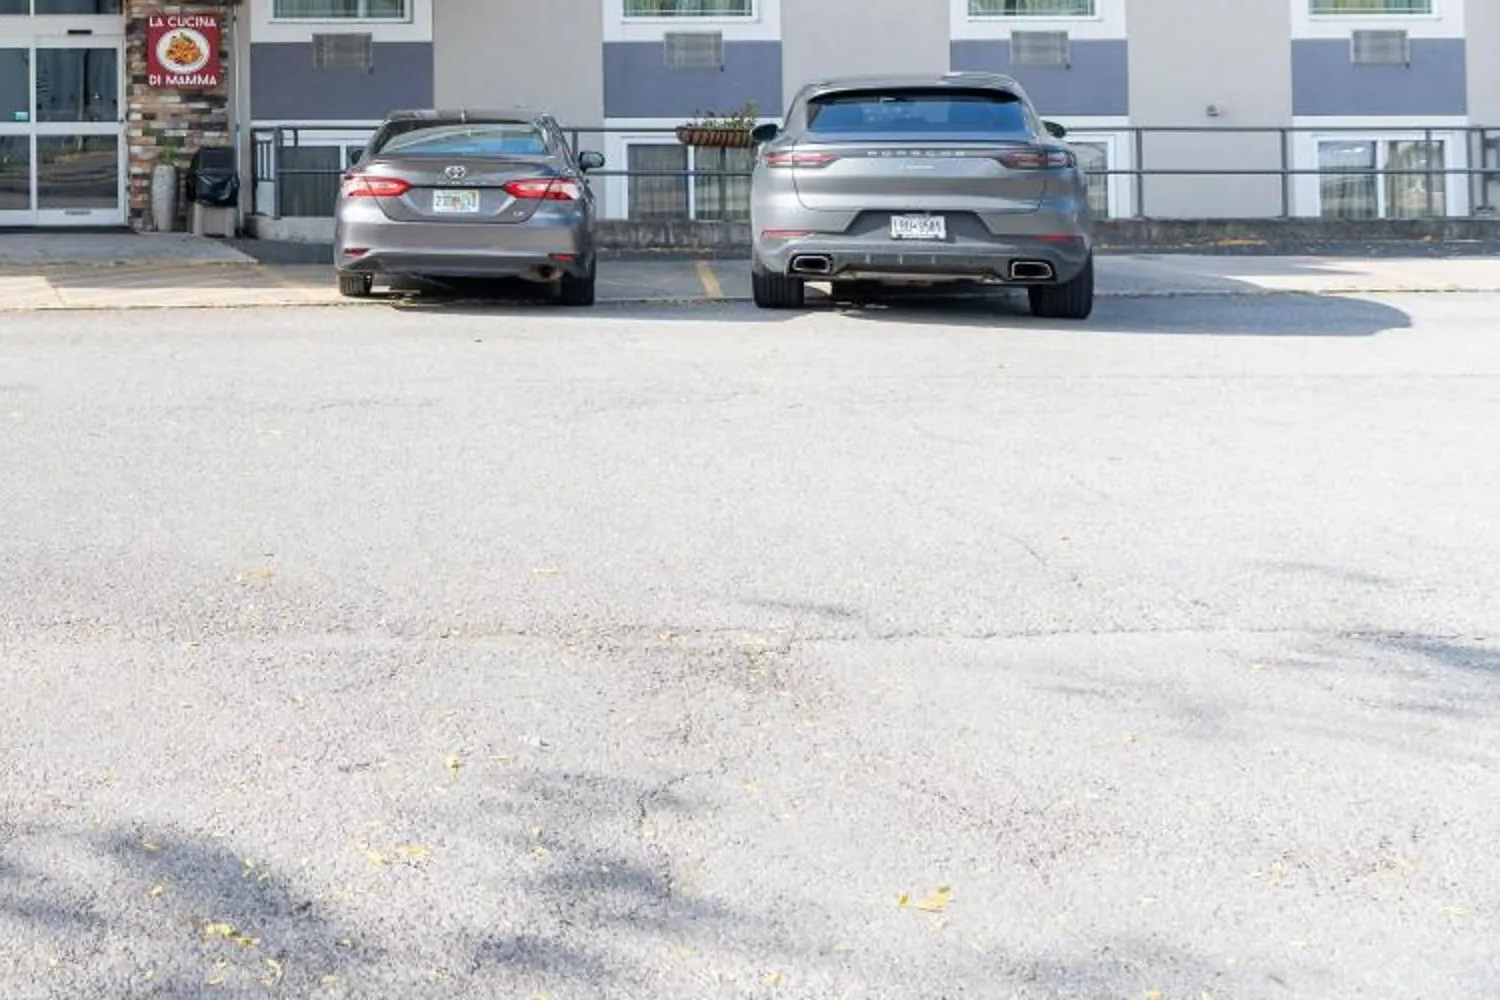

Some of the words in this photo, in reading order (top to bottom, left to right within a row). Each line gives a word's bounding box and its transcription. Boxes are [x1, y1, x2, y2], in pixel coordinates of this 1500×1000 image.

[149, 15, 164, 27] LA
[167, 15, 216, 27] CUCINA
[149, 73, 161, 86] DI
[165, 73, 217, 86] MAMMA
